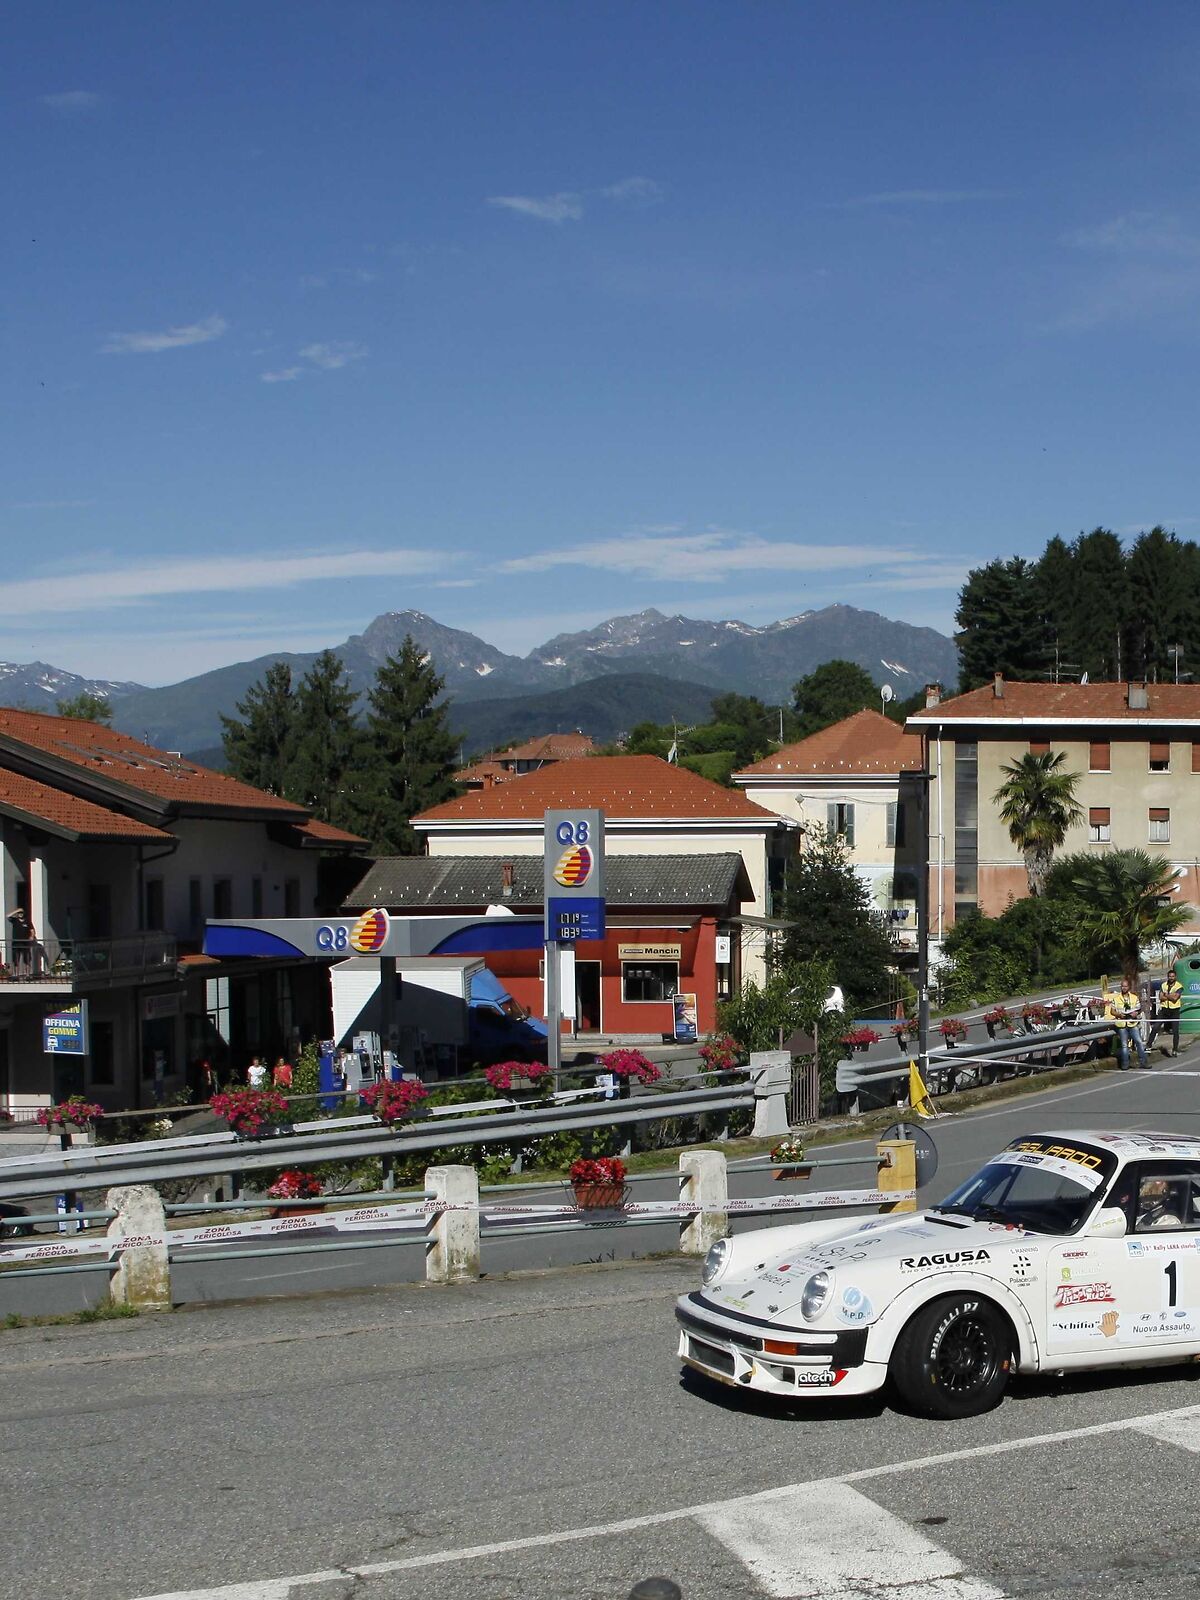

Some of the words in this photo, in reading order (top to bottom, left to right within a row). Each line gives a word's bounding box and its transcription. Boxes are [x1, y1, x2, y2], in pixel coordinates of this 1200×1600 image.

[556, 821, 590, 846] Q8
[316, 926, 349, 952] Q8
[45, 1018, 81, 1028] OFFICINA
[48, 1027, 78, 1036] GOMME
[355, 1208, 379, 1216] ZONA
[281, 1217, 307, 1225] ZONA
[204, 1226, 231, 1234] ZONA
[123, 1235, 152, 1243] ZONA
[37, 1244, 67, 1252] ZONA
[900, 1249, 991, 1269] RAGUSA
[935, 1259, 993, 1271] ABSORBERS
[1164, 1260, 1177, 1307] 1
[930, 1307, 960, 1360] PIRELLI
[963, 1302, 979, 1313] P7
[1132, 1325, 1158, 1334] Nuova
[1160, 1322, 1191, 1332] Assauto
[798, 1369, 833, 1383] atech
